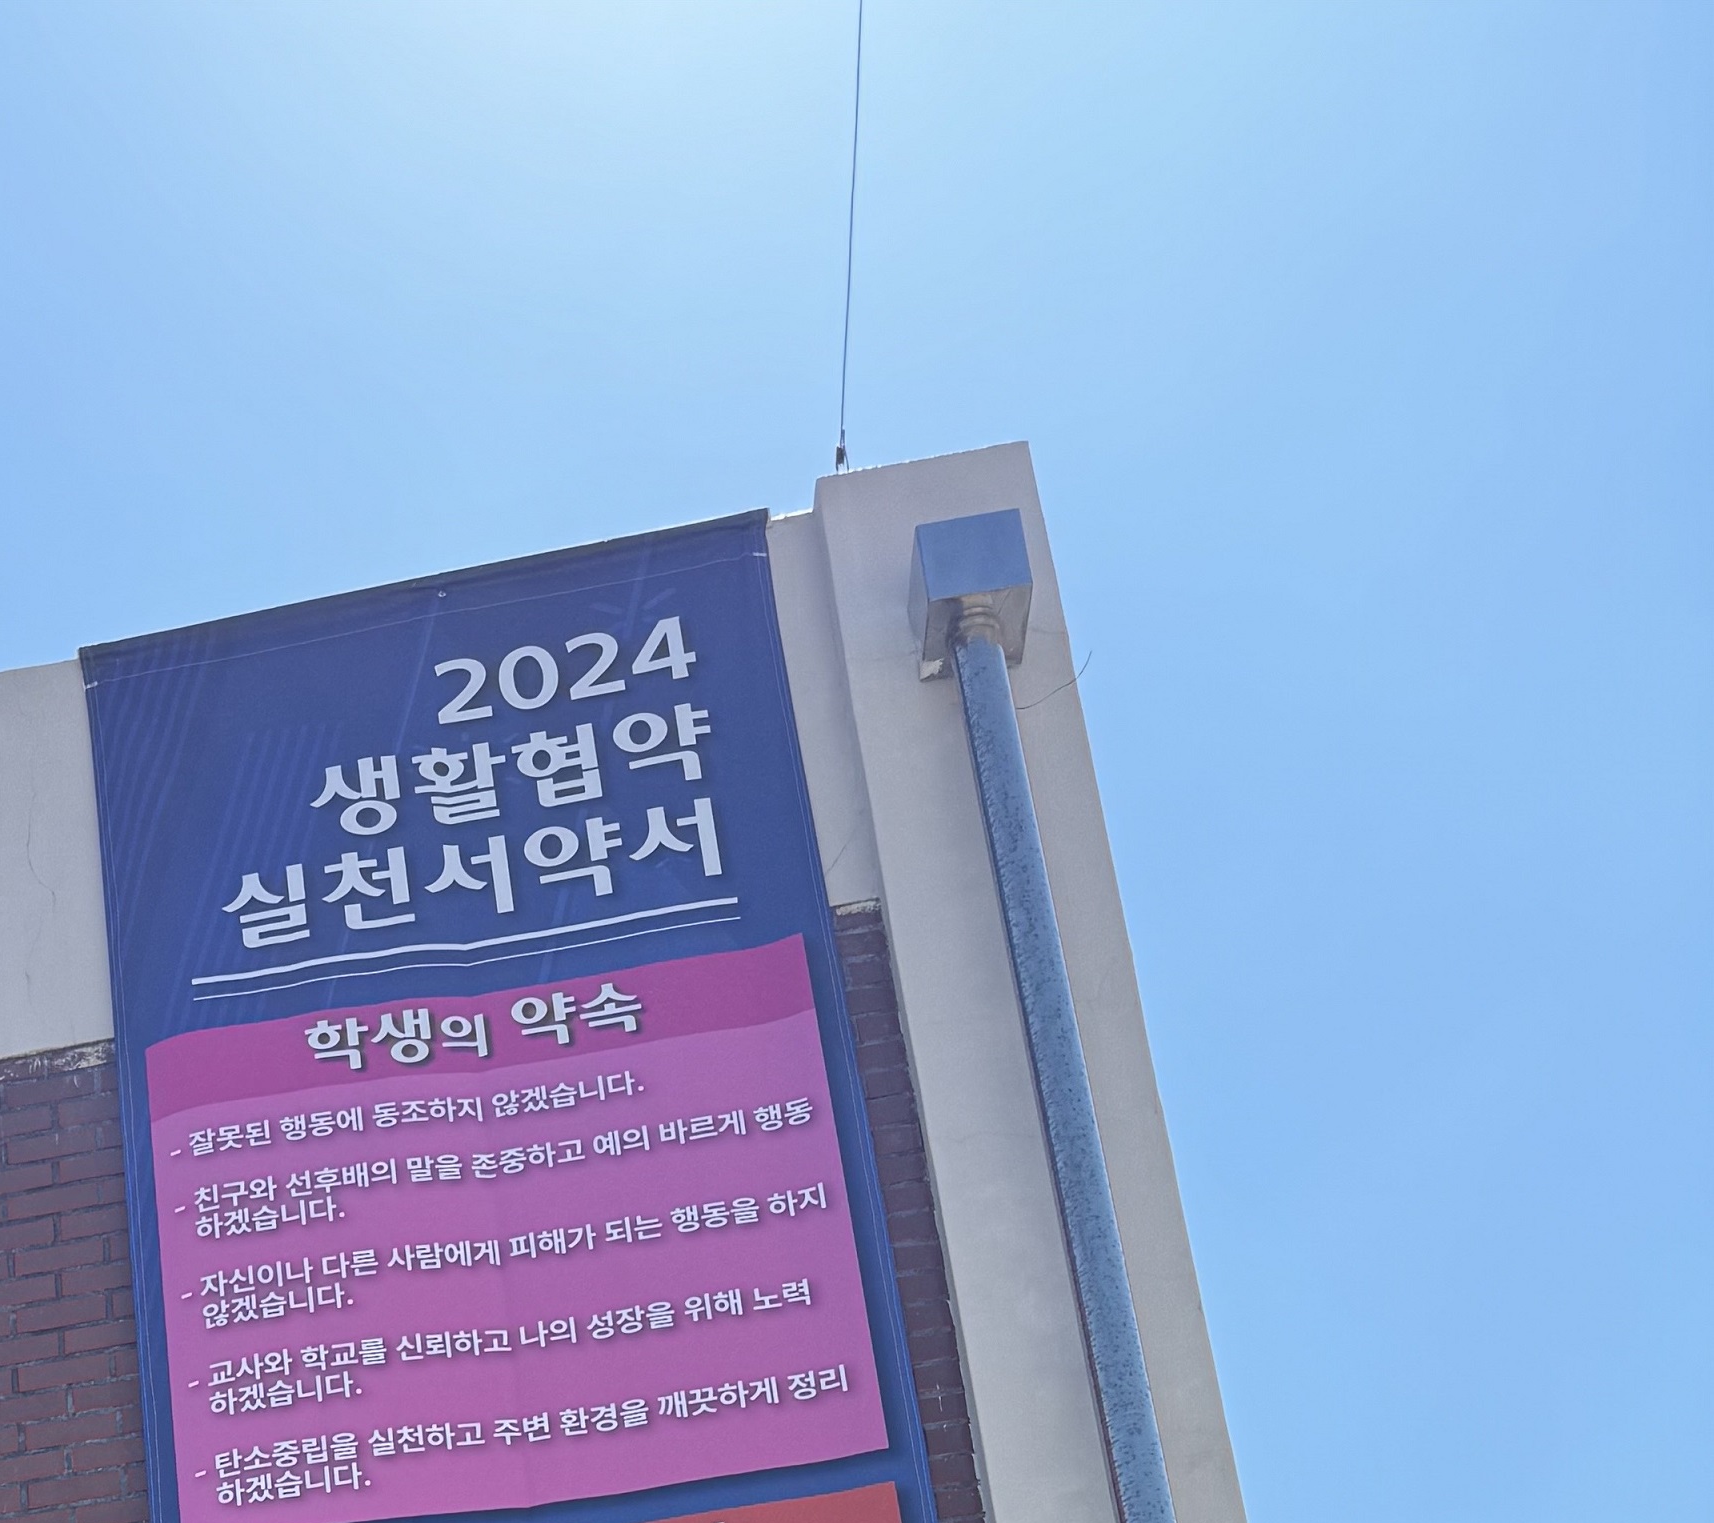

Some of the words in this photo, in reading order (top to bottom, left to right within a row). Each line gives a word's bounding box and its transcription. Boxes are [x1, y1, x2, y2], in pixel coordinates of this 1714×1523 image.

[433, 615, 697, 725] 2024
[309, 702, 712, 836] 생활협약
[221, 797, 723, 949] 실천서약서
[304, 1007, 489, 1070] 학생의
[510, 982, 642, 1045] 약속
[188, 1119, 272, 1157] 잘못된
[279, 1105, 364, 1141] 행동에
[372, 1096, 484, 1128] 동조하지
[491, 1070, 645, 1118] 않겠습니다.
[194, 1175, 278, 1213] 친구와
[285, 1158, 397, 1198] 선후배의
[406, 1154, 463, 1183] 말을
[471, 1139, 586, 1179] 존중하고
[592, 1124, 650, 1156] 예의
[658, 1109, 747, 1145] 바르게
[752, 1097, 813, 1131] 행동
[194, 1195, 345, 1239] 하겠습니다.
[200, 1257, 314, 1297] 자신이나
[321, 1248, 379, 1279] 다른
[387, 1239, 501, 1271] 사람에게
[508, 1223, 597, 1259] 피해가
[605, 1215, 663, 1243] 되는
[669, 1197, 760, 1233] 행동을
[766, 1182, 827, 1217] 하지
[202, 1282, 354, 1330] 않겠습니다.
[207, 1348, 293, 1387] 교사와
[299, 1337, 387, 1371] 학교를
[395, 1328, 512, 1361] 신뢰하고
[519, 1316, 577, 1348] 나의
[586, 1301, 675, 1340] 성장을
[684, 1288, 744, 1322] 위해
[752, 1278, 811, 1311] 노력
[208, 1370, 362, 1416] 하겠습니다.
[214, 1432, 359, 1479] 탄소중립을
[367, 1422, 486, 1457] 실천하고
[492, 1411, 552, 1446] 주변
[558, 1398, 649, 1436] 환경을
[657, 1376, 780, 1418] 깨끗하게
[786, 1363, 848, 1400] 정리
[215, 1461, 371, 1507] 하겠습니다.
